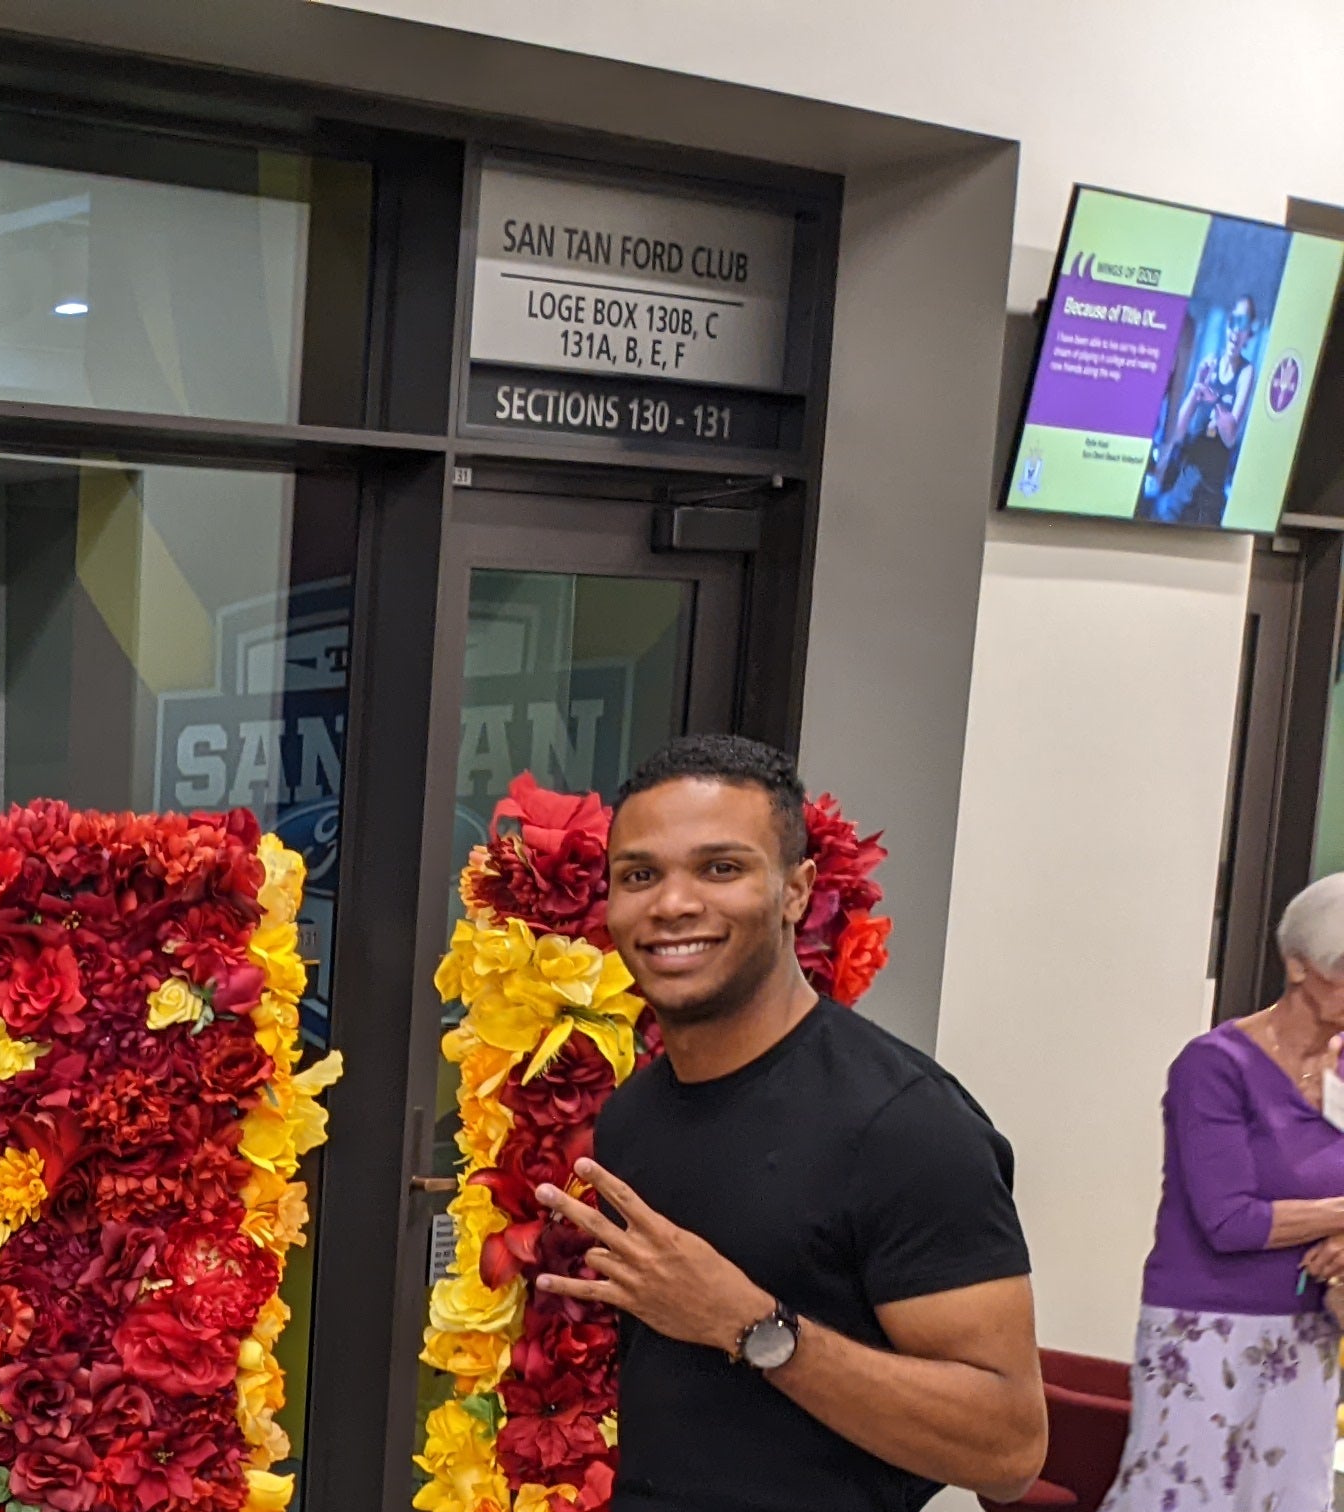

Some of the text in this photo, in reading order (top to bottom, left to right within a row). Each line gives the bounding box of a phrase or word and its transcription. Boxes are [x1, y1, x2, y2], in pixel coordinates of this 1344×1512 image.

[503, 219, 748, 283] SAN TAN FORD CLUB
[528, 290, 719, 340] LOGE BOX 130B, C
[560, 329, 686, 371] 131A, B, E, F
[495, 385, 620, 429] SECTIONS
[628, 398, 671, 433] 130
[693, 404, 731, 440] 131
[176, 700, 604, 807] SAN AN
